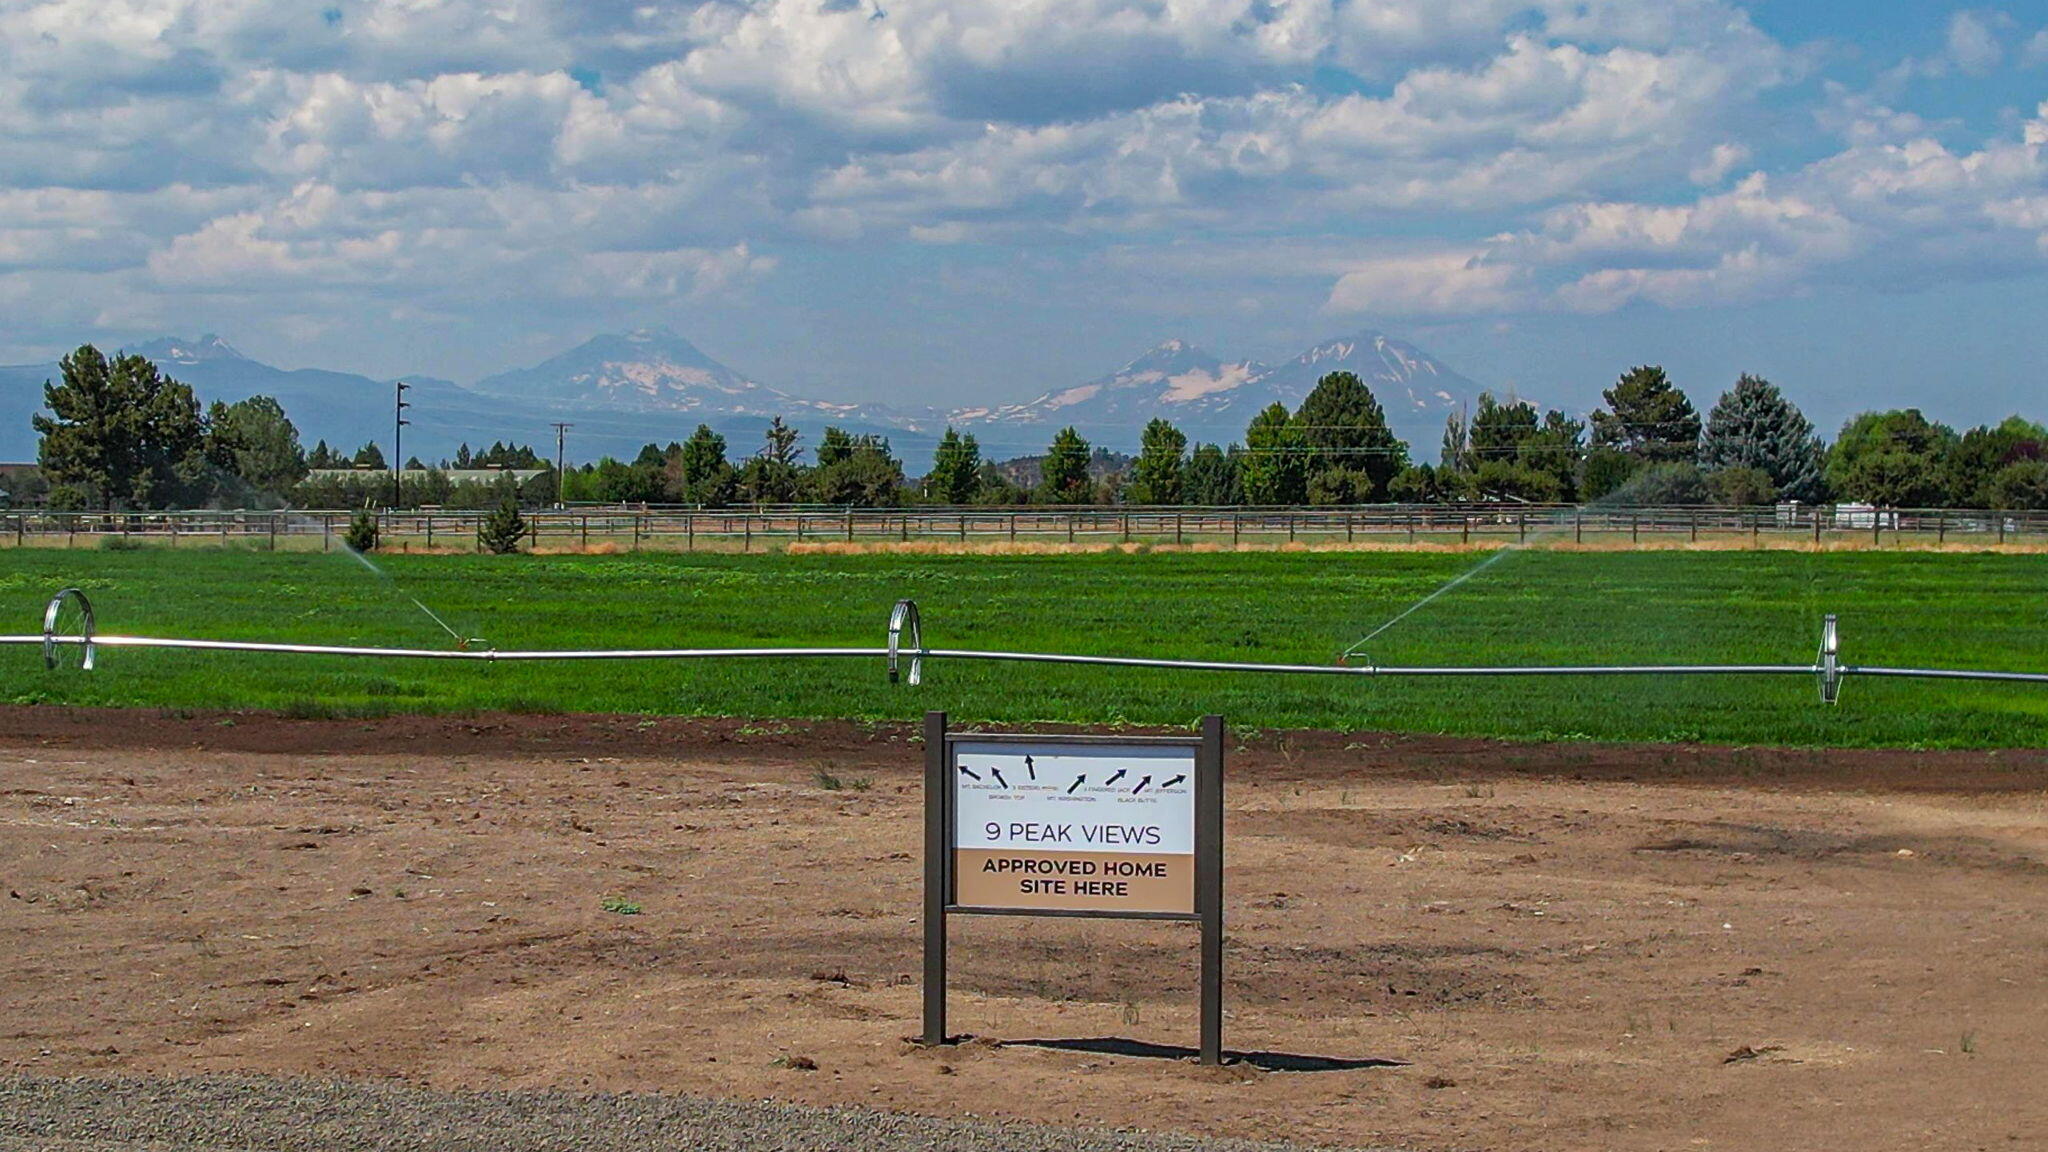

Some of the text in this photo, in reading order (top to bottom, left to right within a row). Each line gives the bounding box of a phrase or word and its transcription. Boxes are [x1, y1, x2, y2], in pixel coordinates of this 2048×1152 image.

[986, 822, 1161, 845] 9 PEAK VIEWS
[983, 859, 1166, 877] APPROVED HOME
[1021, 880, 1128, 896] SITE HERE
